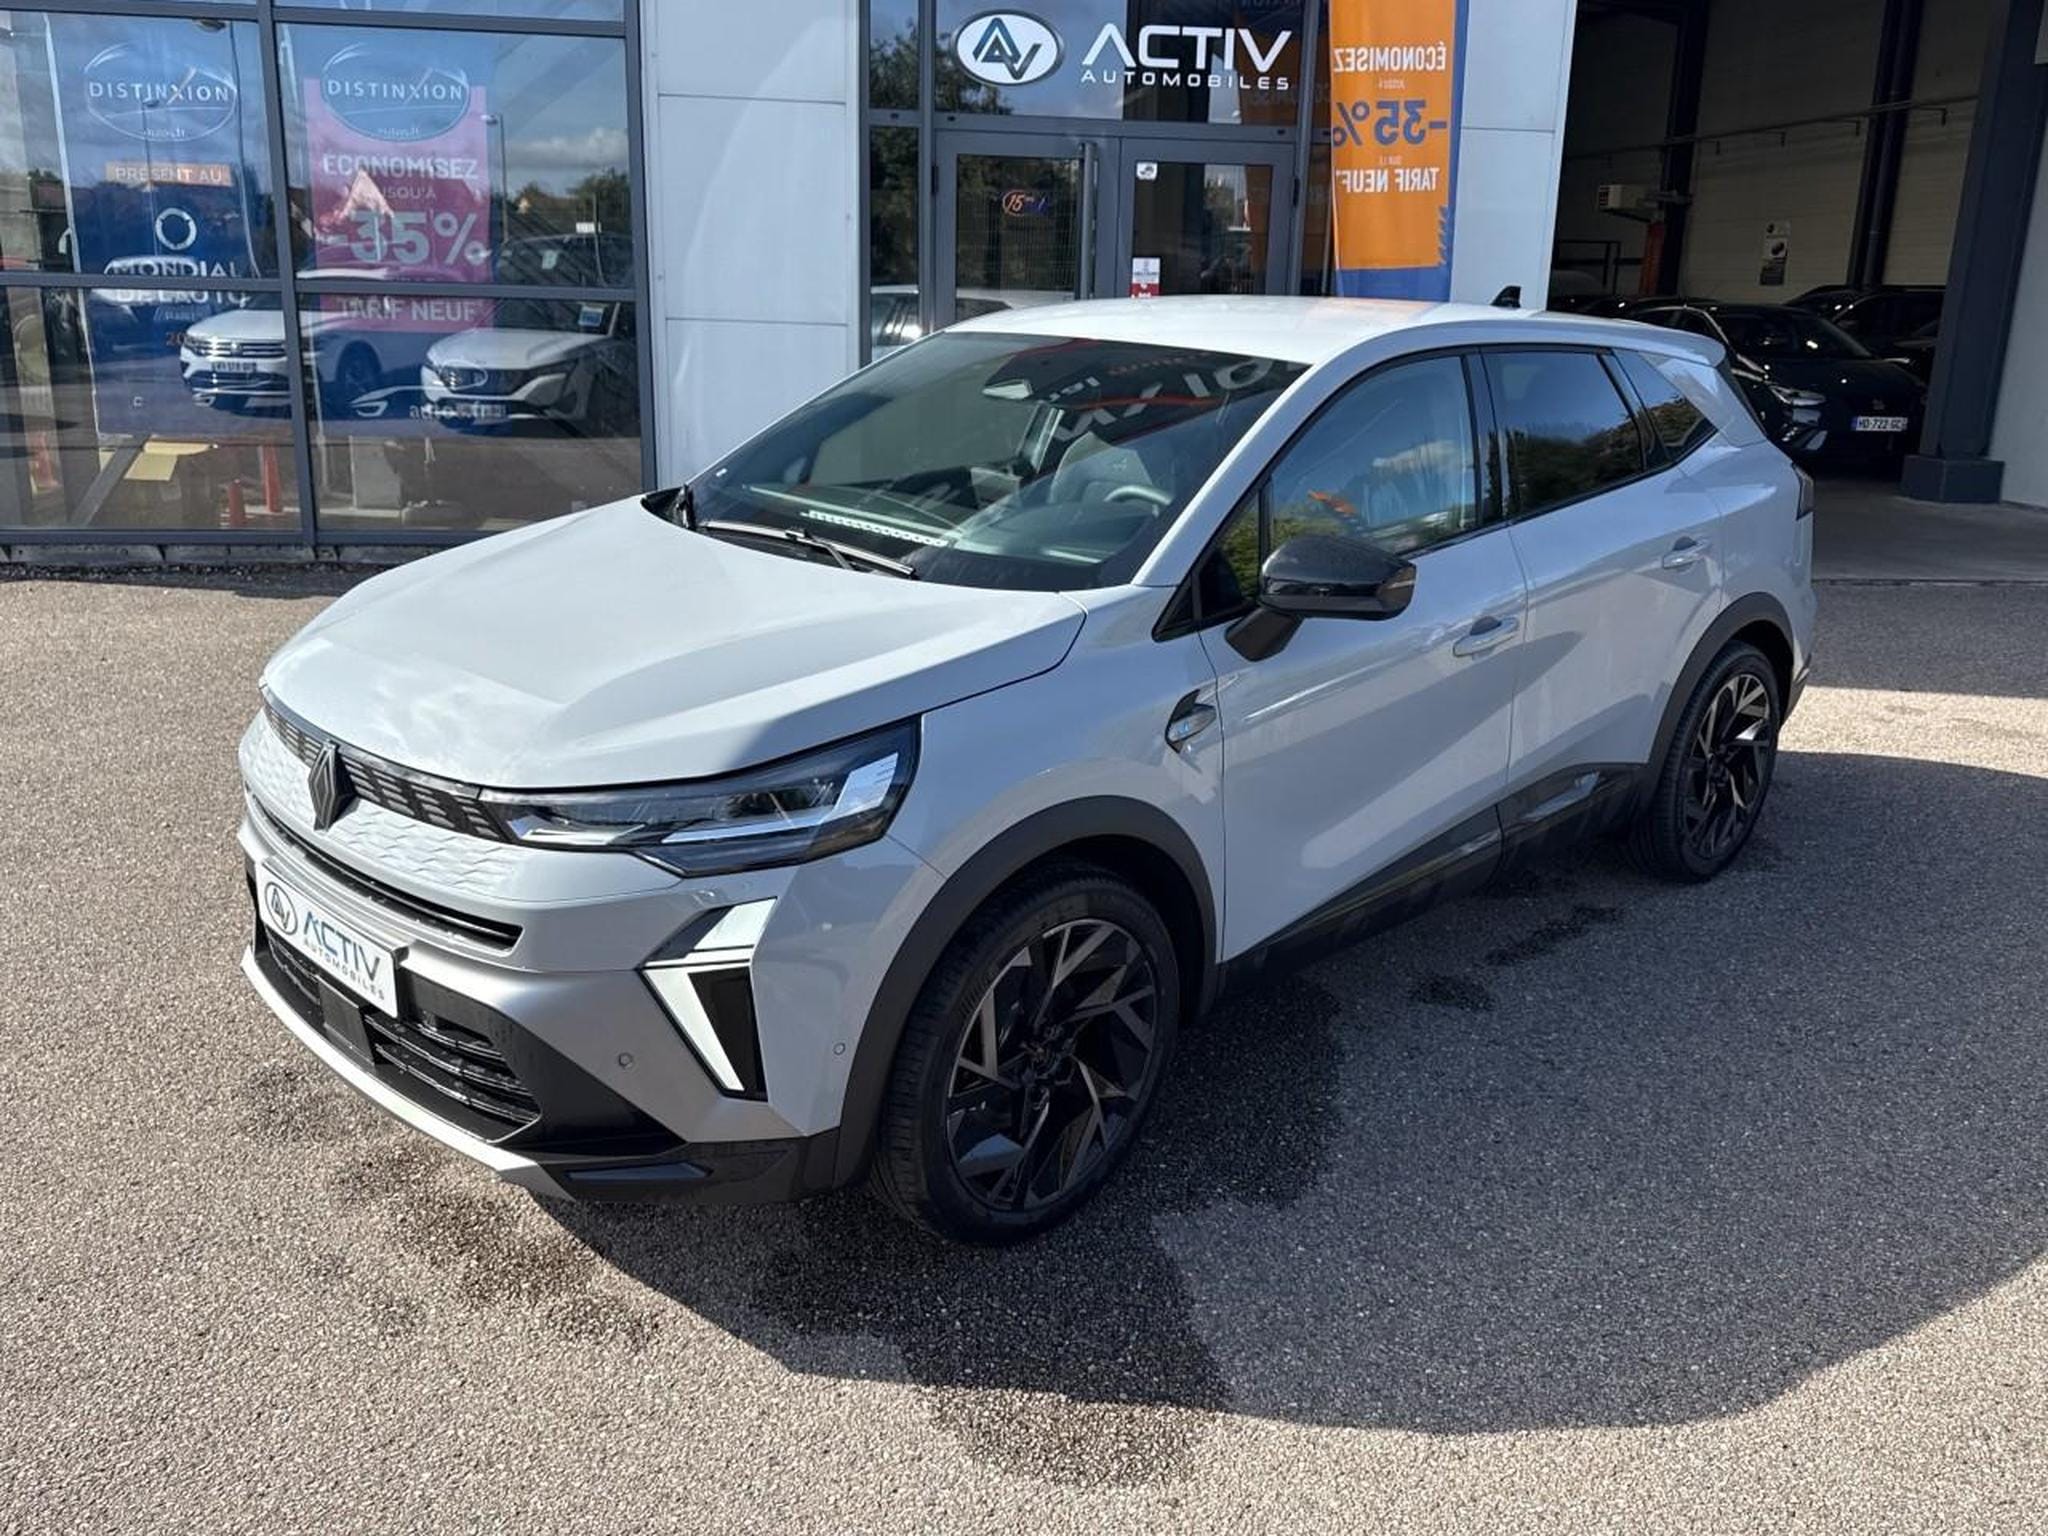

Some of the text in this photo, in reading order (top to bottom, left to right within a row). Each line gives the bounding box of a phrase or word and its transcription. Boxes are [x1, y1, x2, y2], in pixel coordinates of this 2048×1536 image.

[1082, 23, 1293, 73] ACTIV
[89, 78, 229, 103] DISTINXION
[327, 78, 463, 103] DISTINXION
[1081, 70, 1290, 90] AUTOMOBILES
[200, 169, 223, 183] AU
[303, 911, 381, 982] ACTIV
[303, 937, 385, 1001] AUTOMOBILES
